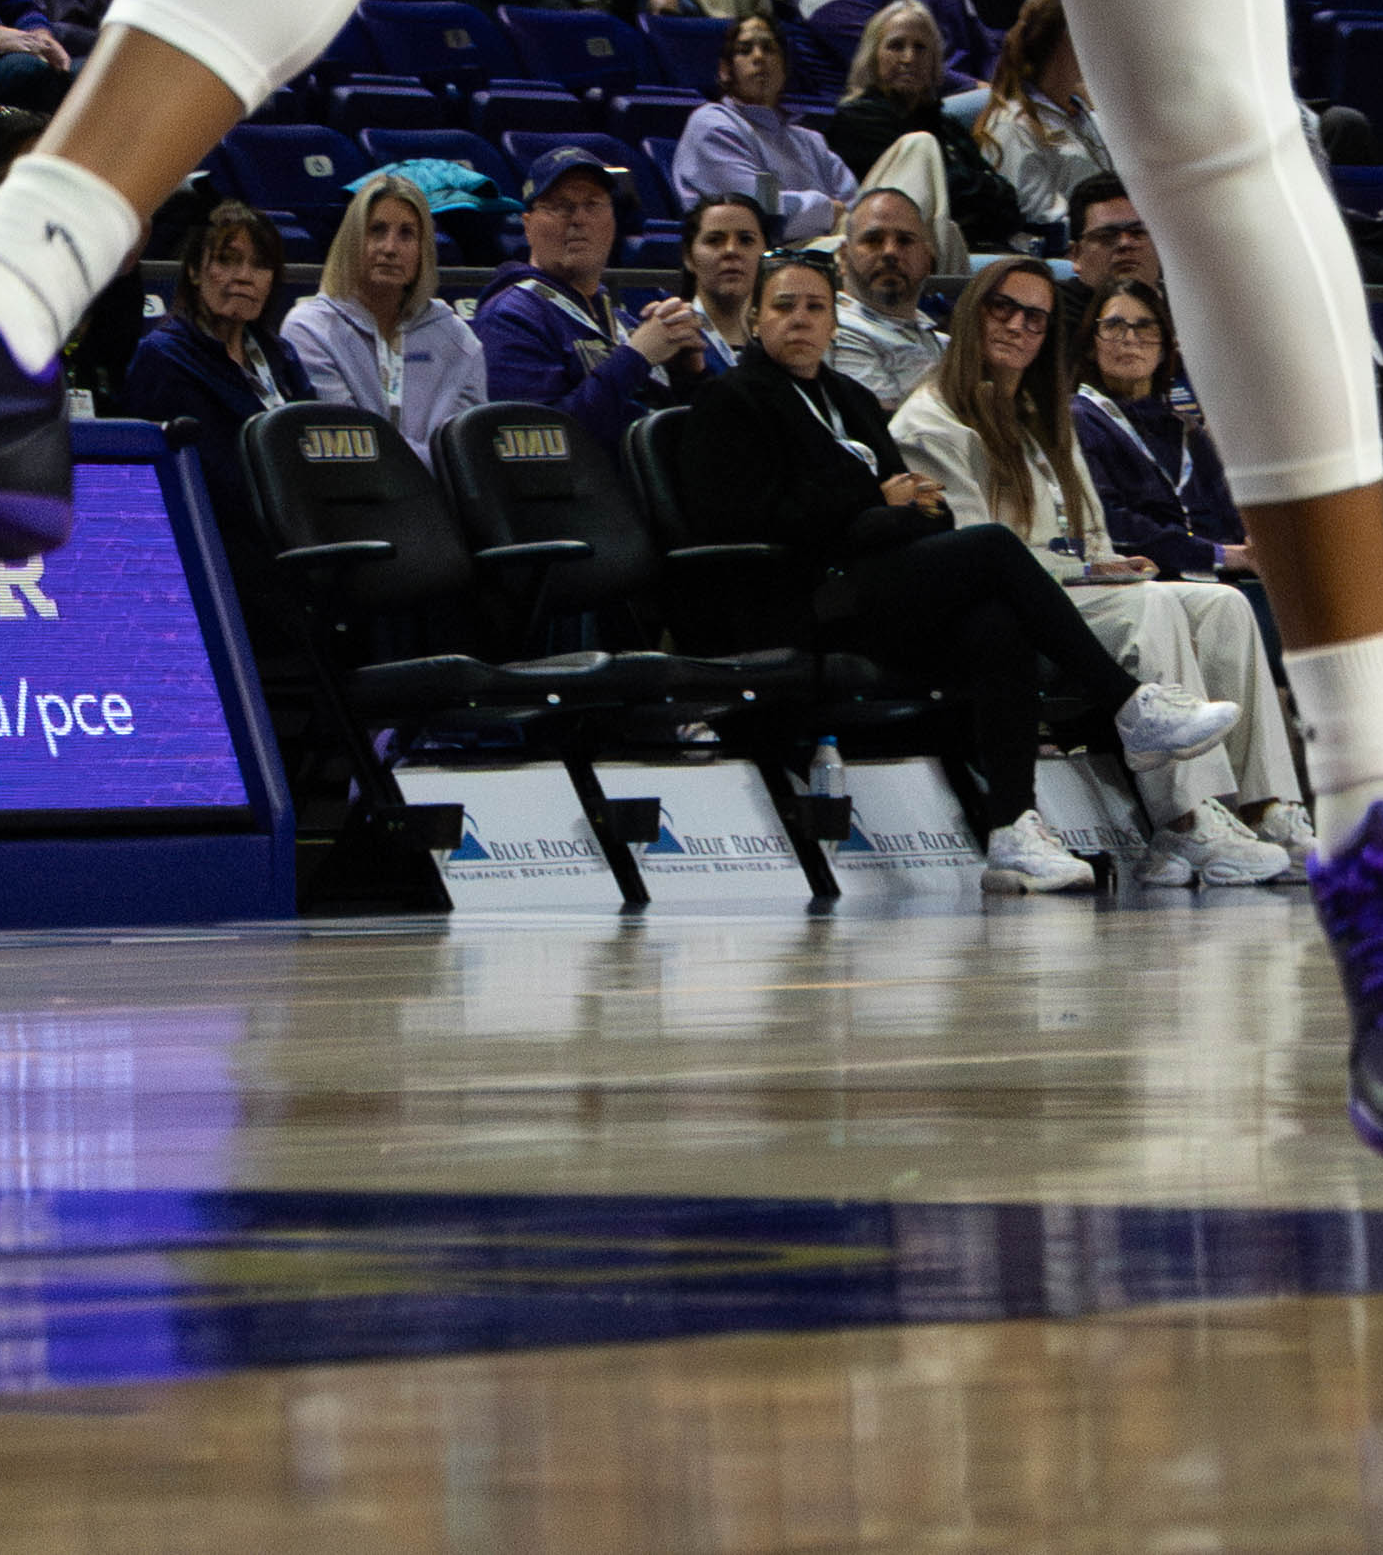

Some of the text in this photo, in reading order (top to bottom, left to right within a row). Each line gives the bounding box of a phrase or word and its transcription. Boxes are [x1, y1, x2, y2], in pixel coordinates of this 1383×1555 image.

[300, 427, 378, 461] JMU
[493, 425, 569, 461] JMU
[489, 838, 601, 862] BLUE RIDGE
[683, 834, 789, 856] BLUE RIDGE
